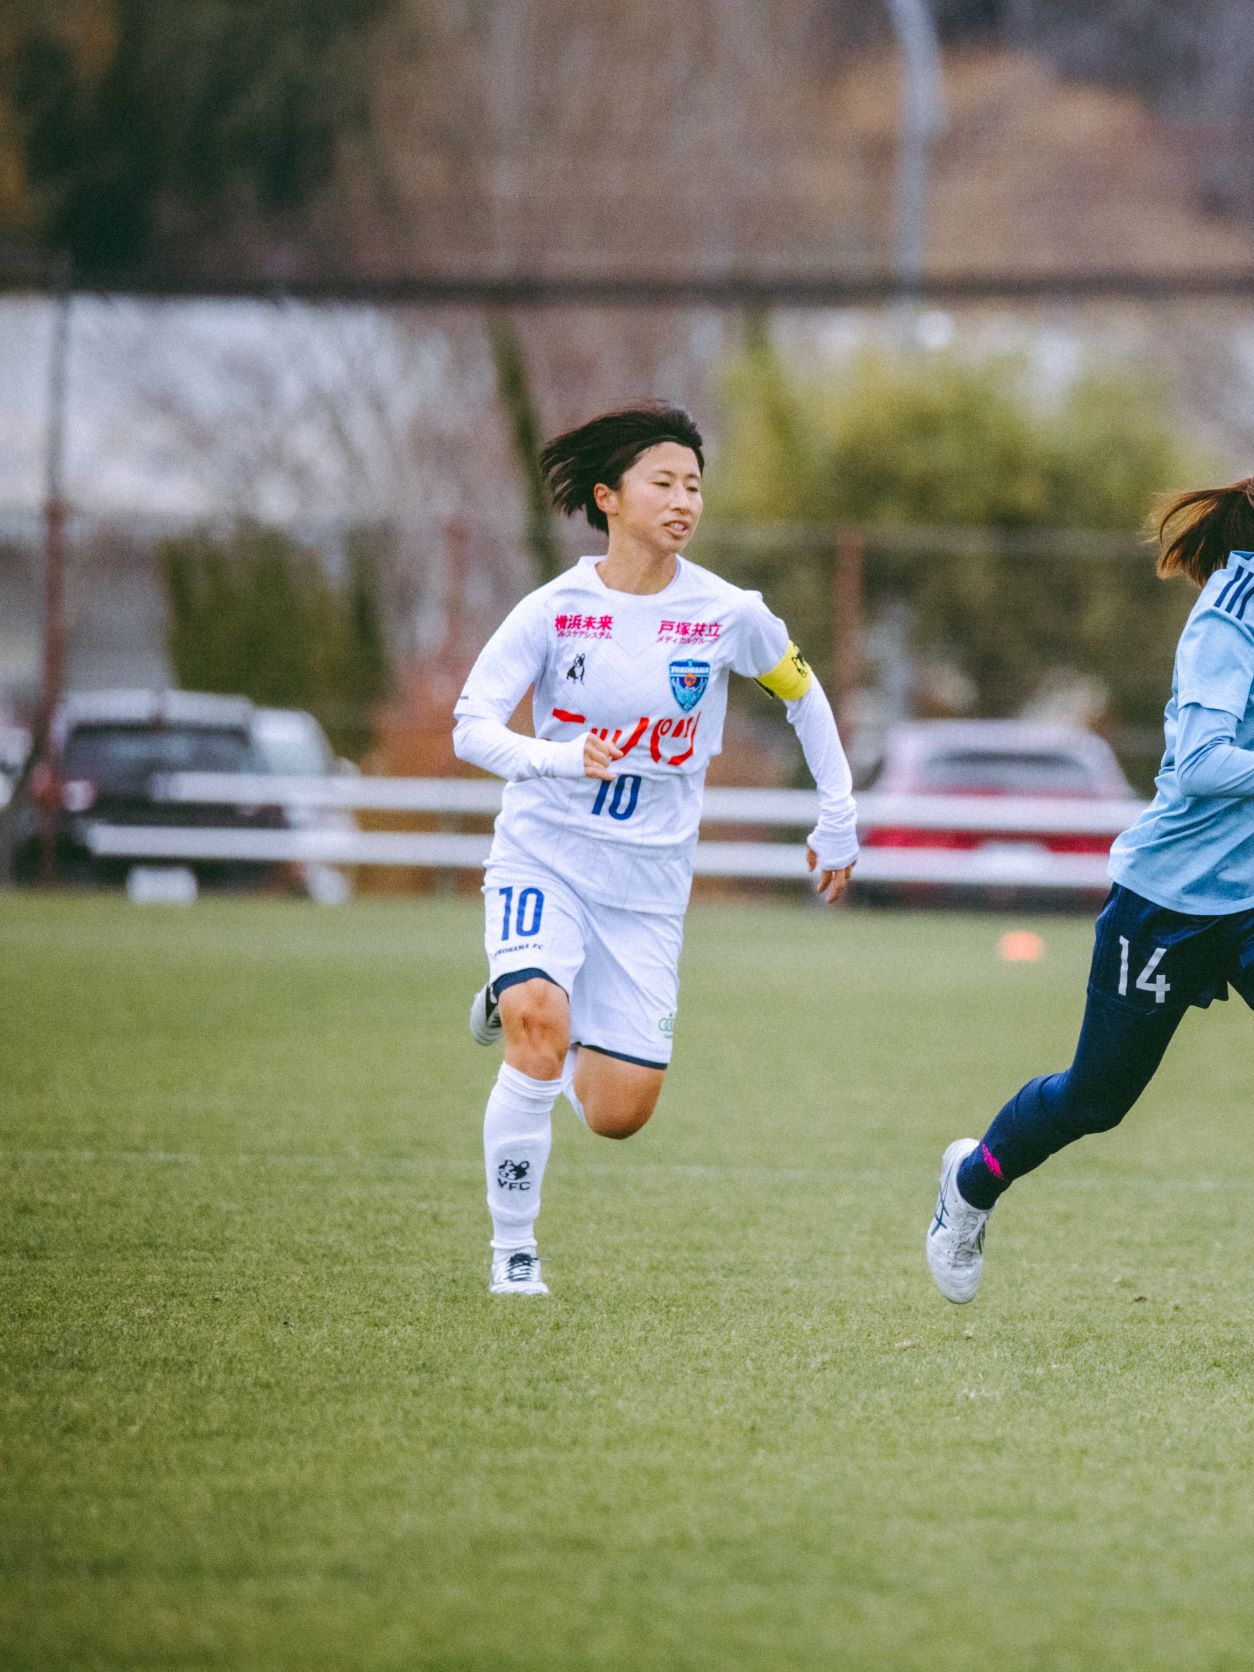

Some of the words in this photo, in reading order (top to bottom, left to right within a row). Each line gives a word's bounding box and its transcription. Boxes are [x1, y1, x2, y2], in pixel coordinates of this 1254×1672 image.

[555, 614, 613, 630] 横浜未来
[658, 620, 722, 637] 戸塚共立
[592, 774, 642, 821] 10
[499, 886, 545, 941] 10
[1118, 935, 1171, 1004] 14
